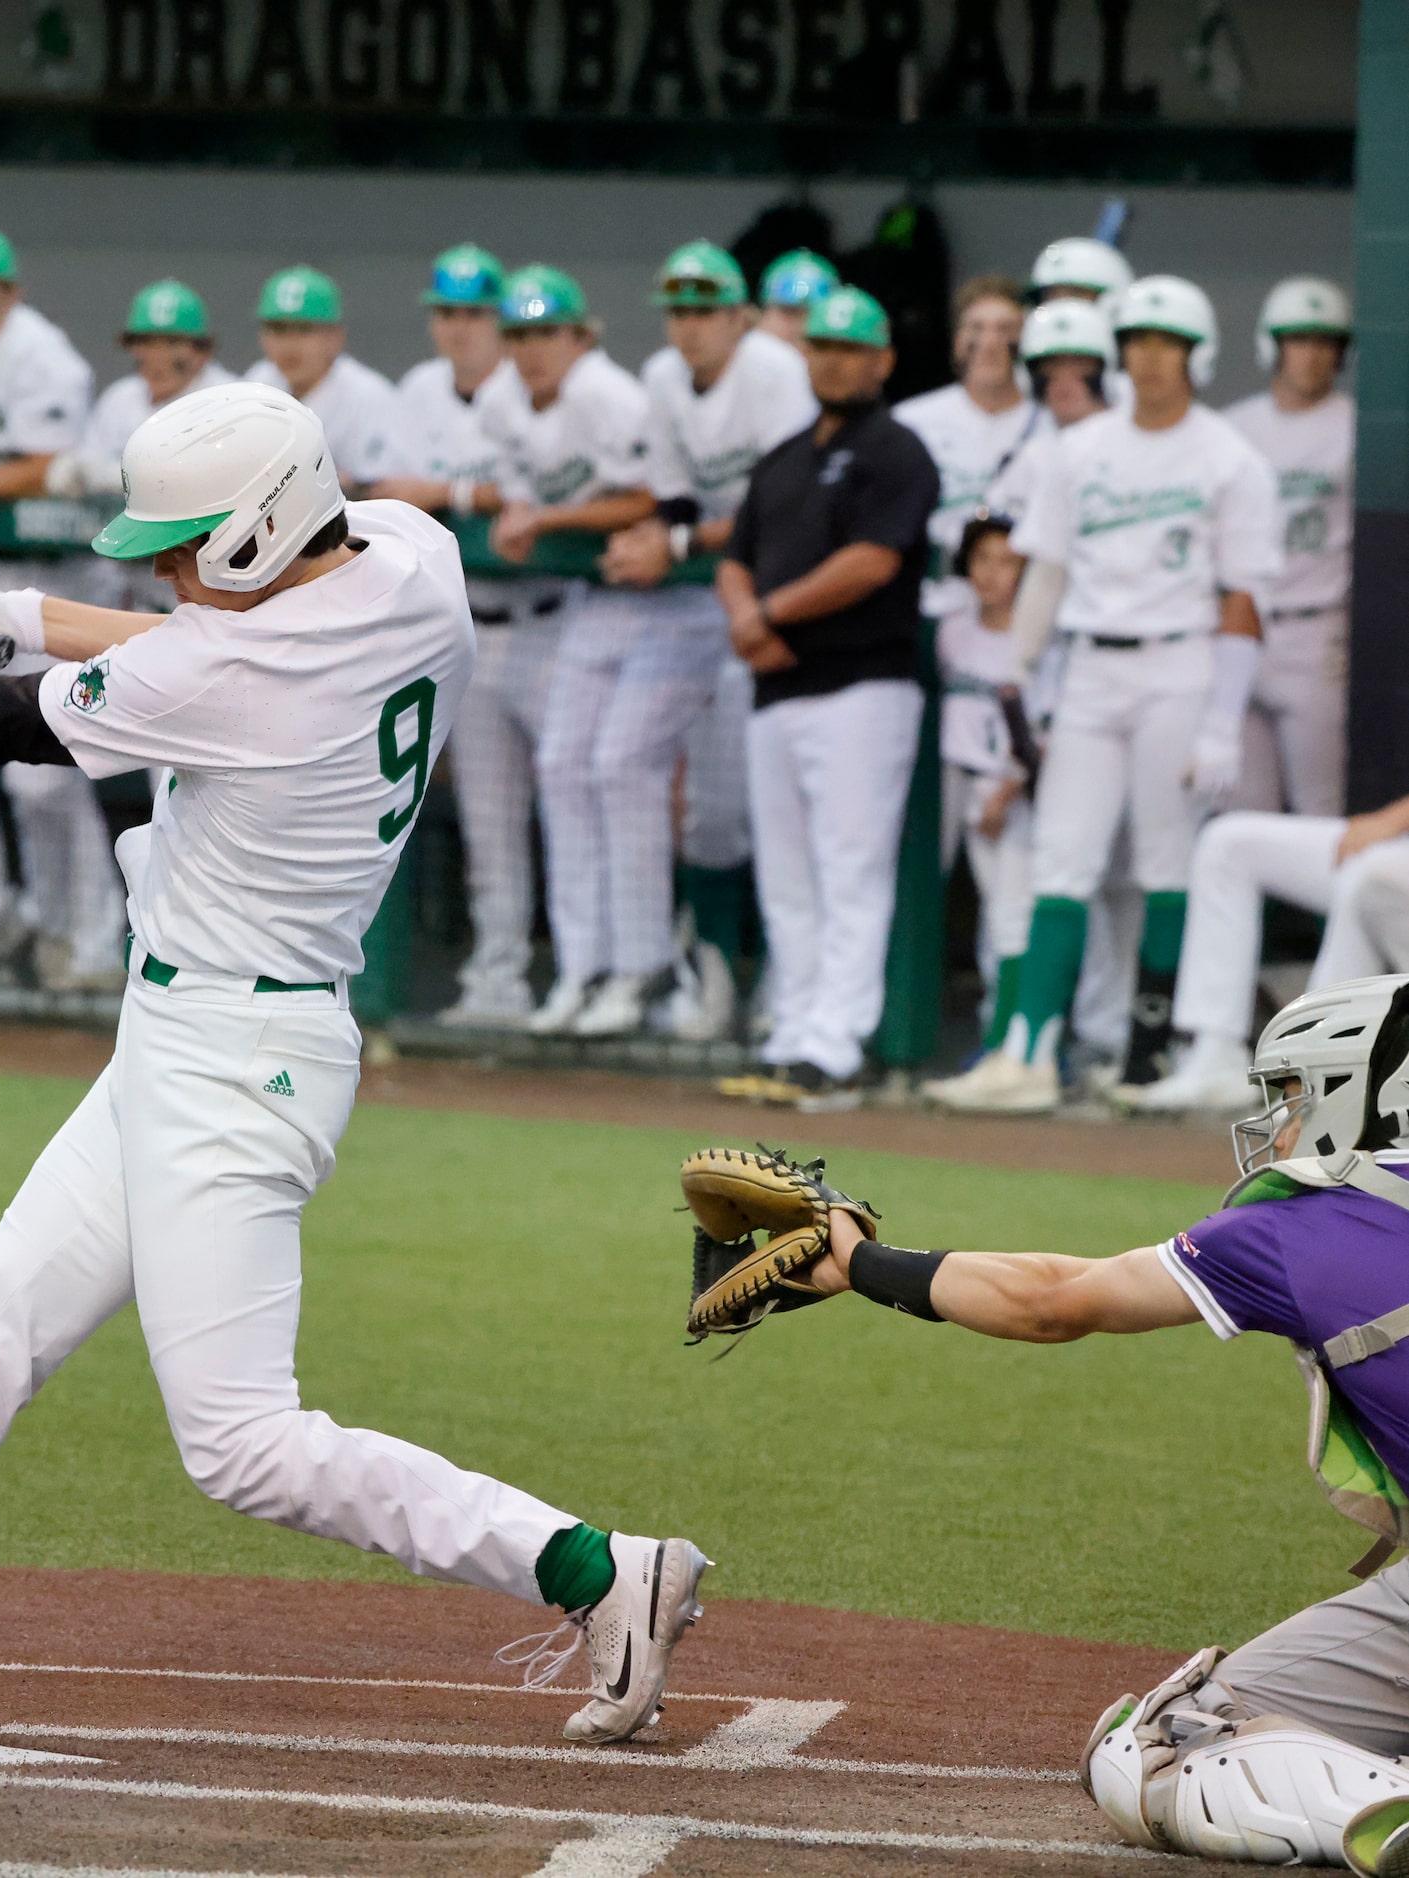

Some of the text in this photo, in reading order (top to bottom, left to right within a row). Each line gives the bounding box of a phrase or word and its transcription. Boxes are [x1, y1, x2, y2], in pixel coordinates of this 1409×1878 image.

[102, 0, 533, 105] DRAGON
[258, 464, 298, 511] RAWLINGS
[378, 676, 437, 845] 9
[263, 1083, 295, 1097] adidas
